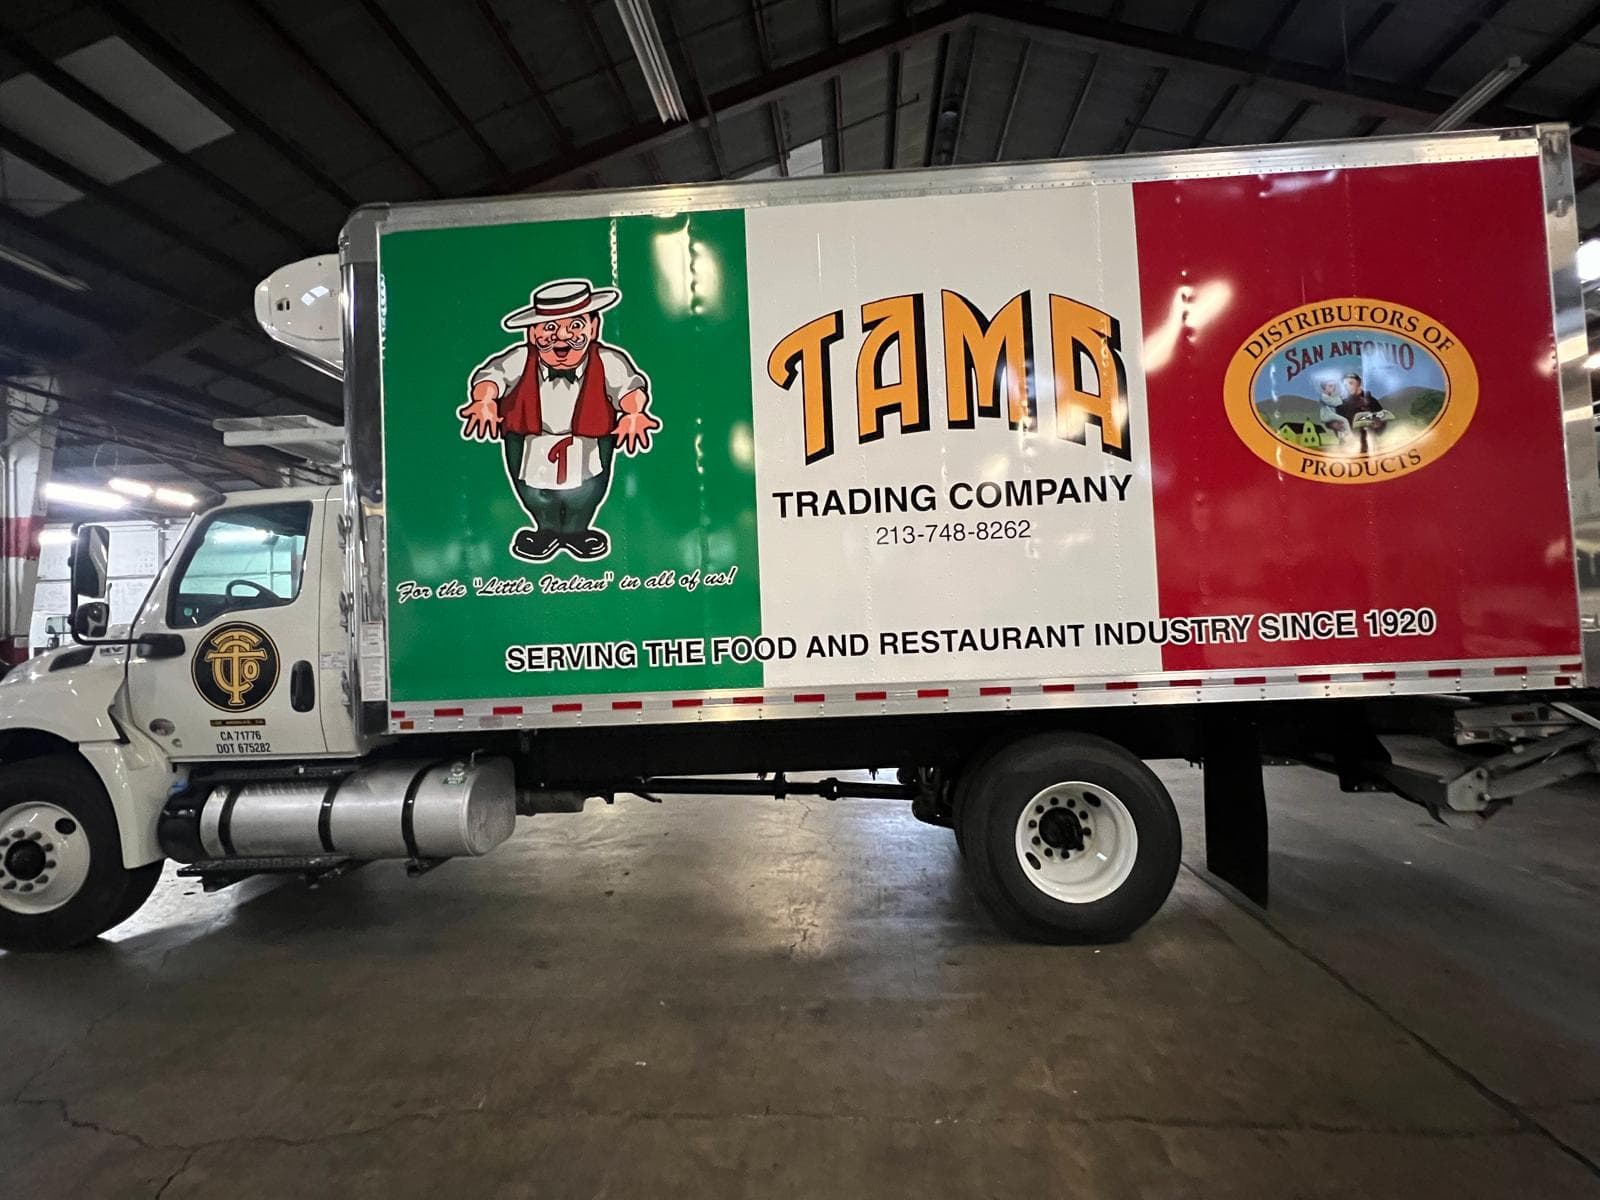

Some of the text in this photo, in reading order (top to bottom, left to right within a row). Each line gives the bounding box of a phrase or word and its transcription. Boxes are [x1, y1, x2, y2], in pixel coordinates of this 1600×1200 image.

[1243, 305, 1455, 360] DISTRIBUTORS OF
[767, 289, 1131, 465] TAMA
[1285, 341, 1414, 381] SAN ANTONIO
[1301, 449, 1421, 478] PRODUCTS
[772, 475, 1132, 518] TRADING COMPANY
[876, 519, 1031, 546] 213-748-8262
[397, 566, 737, 602] For the "Little Italian" in all of us!
[506, 608, 1435, 671] SERVING THE FOOD AND RESTAURANT INDUSTRY SINCE 1920
[216, 742, 271, 753] DOT 675282
[220, 730, 262, 741] CA 71776
